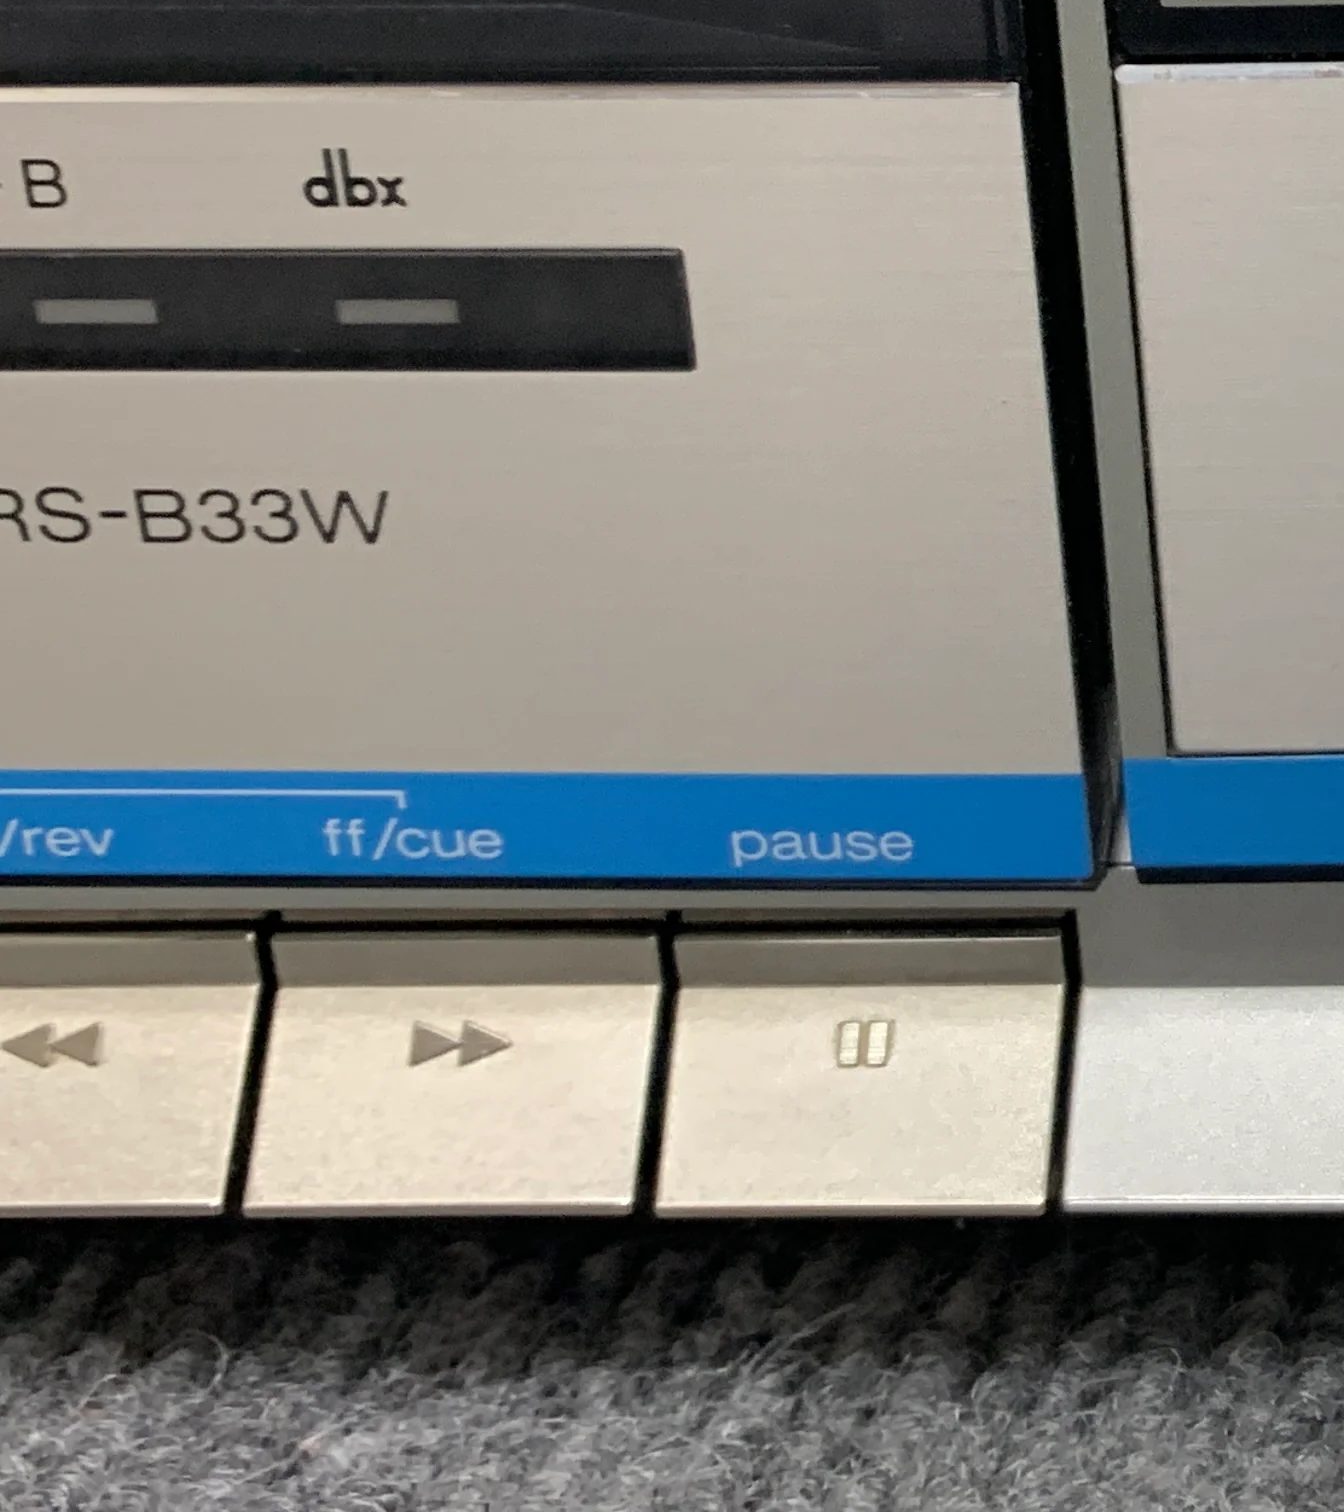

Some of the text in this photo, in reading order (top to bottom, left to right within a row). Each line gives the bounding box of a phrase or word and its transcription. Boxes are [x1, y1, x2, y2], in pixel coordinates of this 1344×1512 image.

[19, 157, 69, 210] B
[302, 147, 408, 209] dbx
[320, 816, 505, 862] ff/cue
[728, 828, 915, 869] pause
